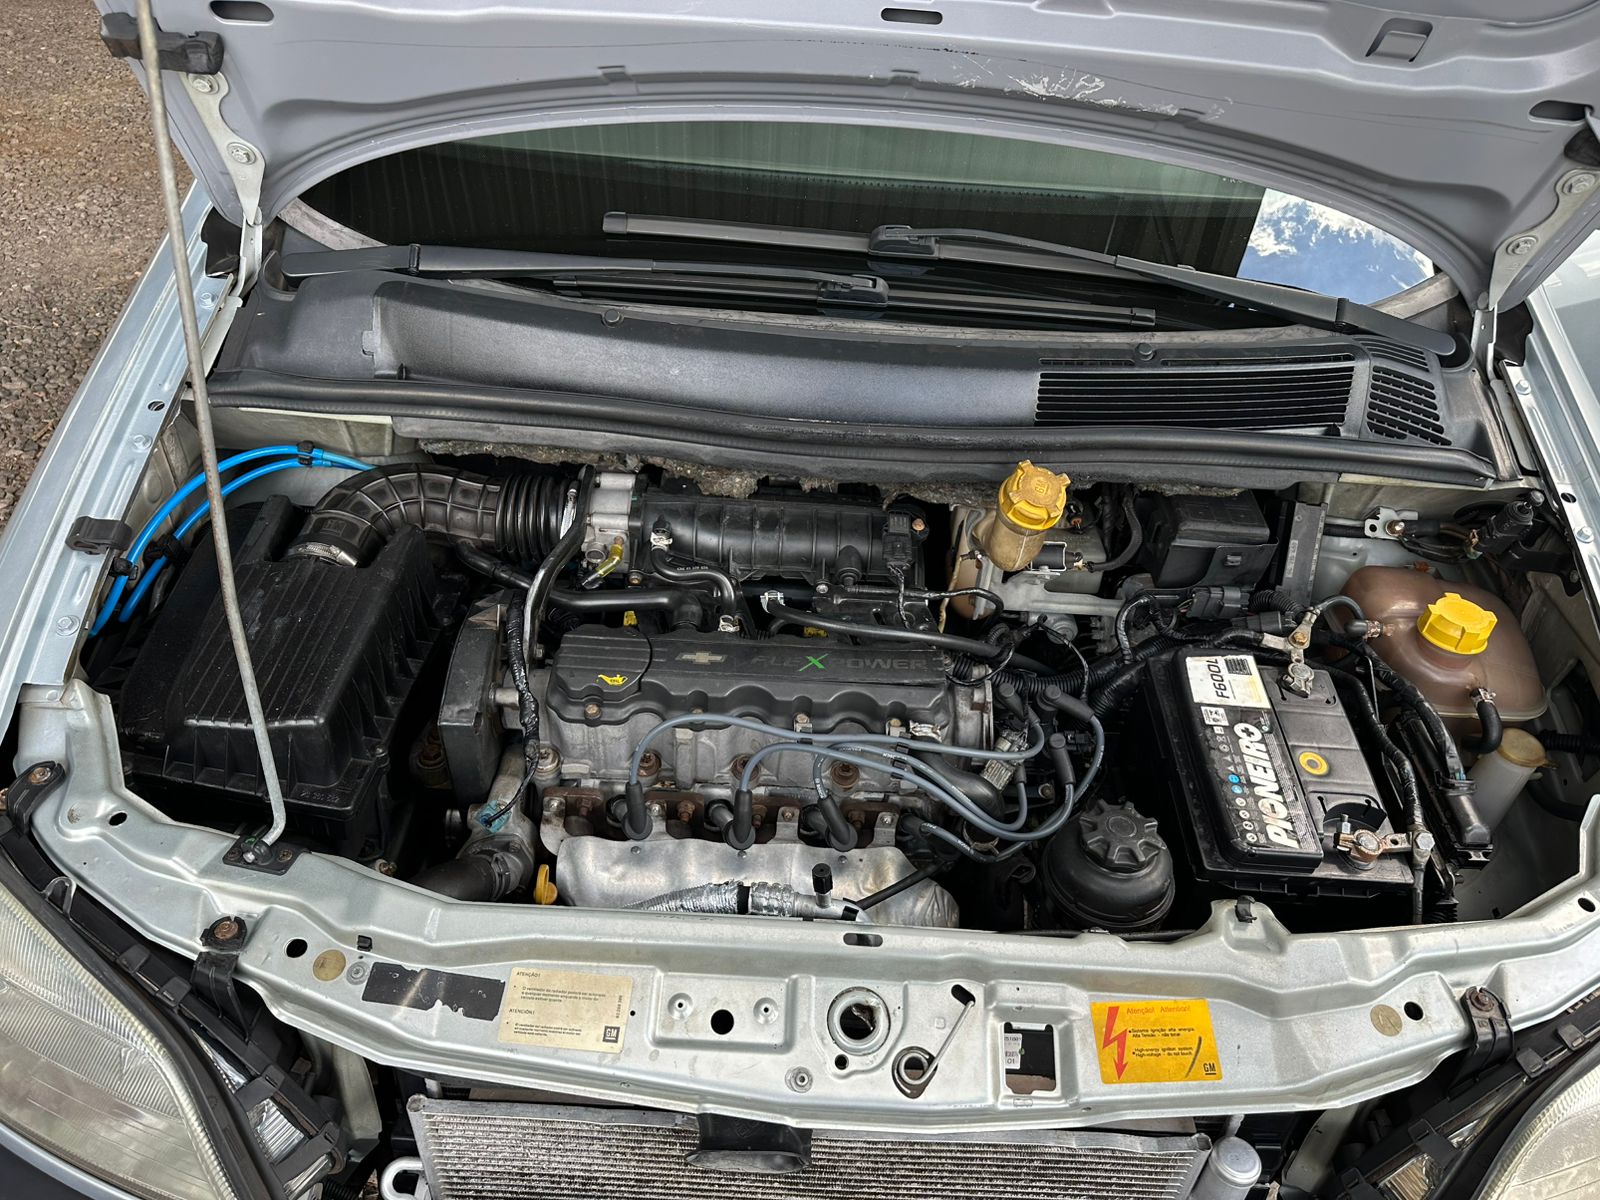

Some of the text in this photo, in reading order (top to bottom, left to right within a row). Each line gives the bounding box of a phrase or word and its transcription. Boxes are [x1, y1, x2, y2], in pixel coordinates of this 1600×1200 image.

[1210, 657, 1230, 699] F600L
[1233, 722, 1300, 849] PIONEIRO
[606, 1028, 617, 1037] GM
[1204, 1063, 1216, 1072] GM
